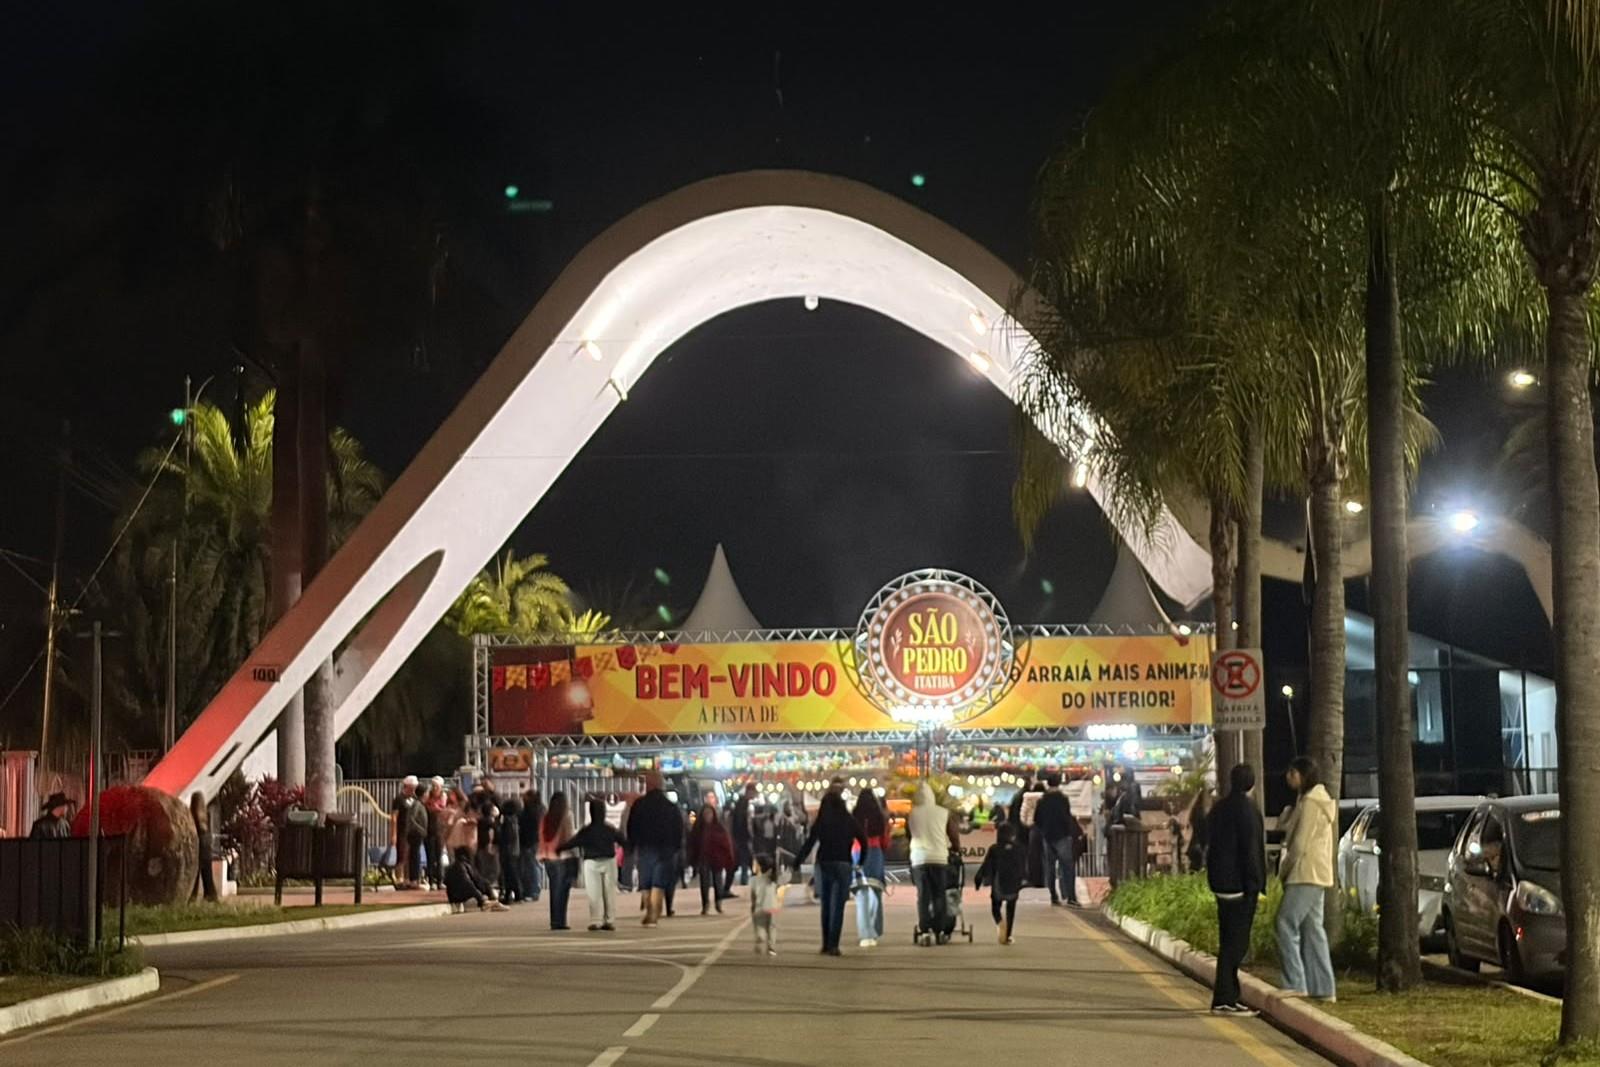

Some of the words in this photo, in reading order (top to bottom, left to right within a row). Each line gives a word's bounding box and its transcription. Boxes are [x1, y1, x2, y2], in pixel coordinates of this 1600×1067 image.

[908, 607, 958, 646] SÃO
[902, 646, 968, 674] PEDRO
[1027, 658, 1092, 683] ARRAIÁ
[1098, 663, 1140, 681] MAIS
[635, 661, 837, 700] BEM-VINDO
[1061, 692, 1086, 709] DO
[1091, 690, 1176, 709] INTERIOR!
[713, 705, 756, 723] FESTA
[760, 704, 779, 723] DE
